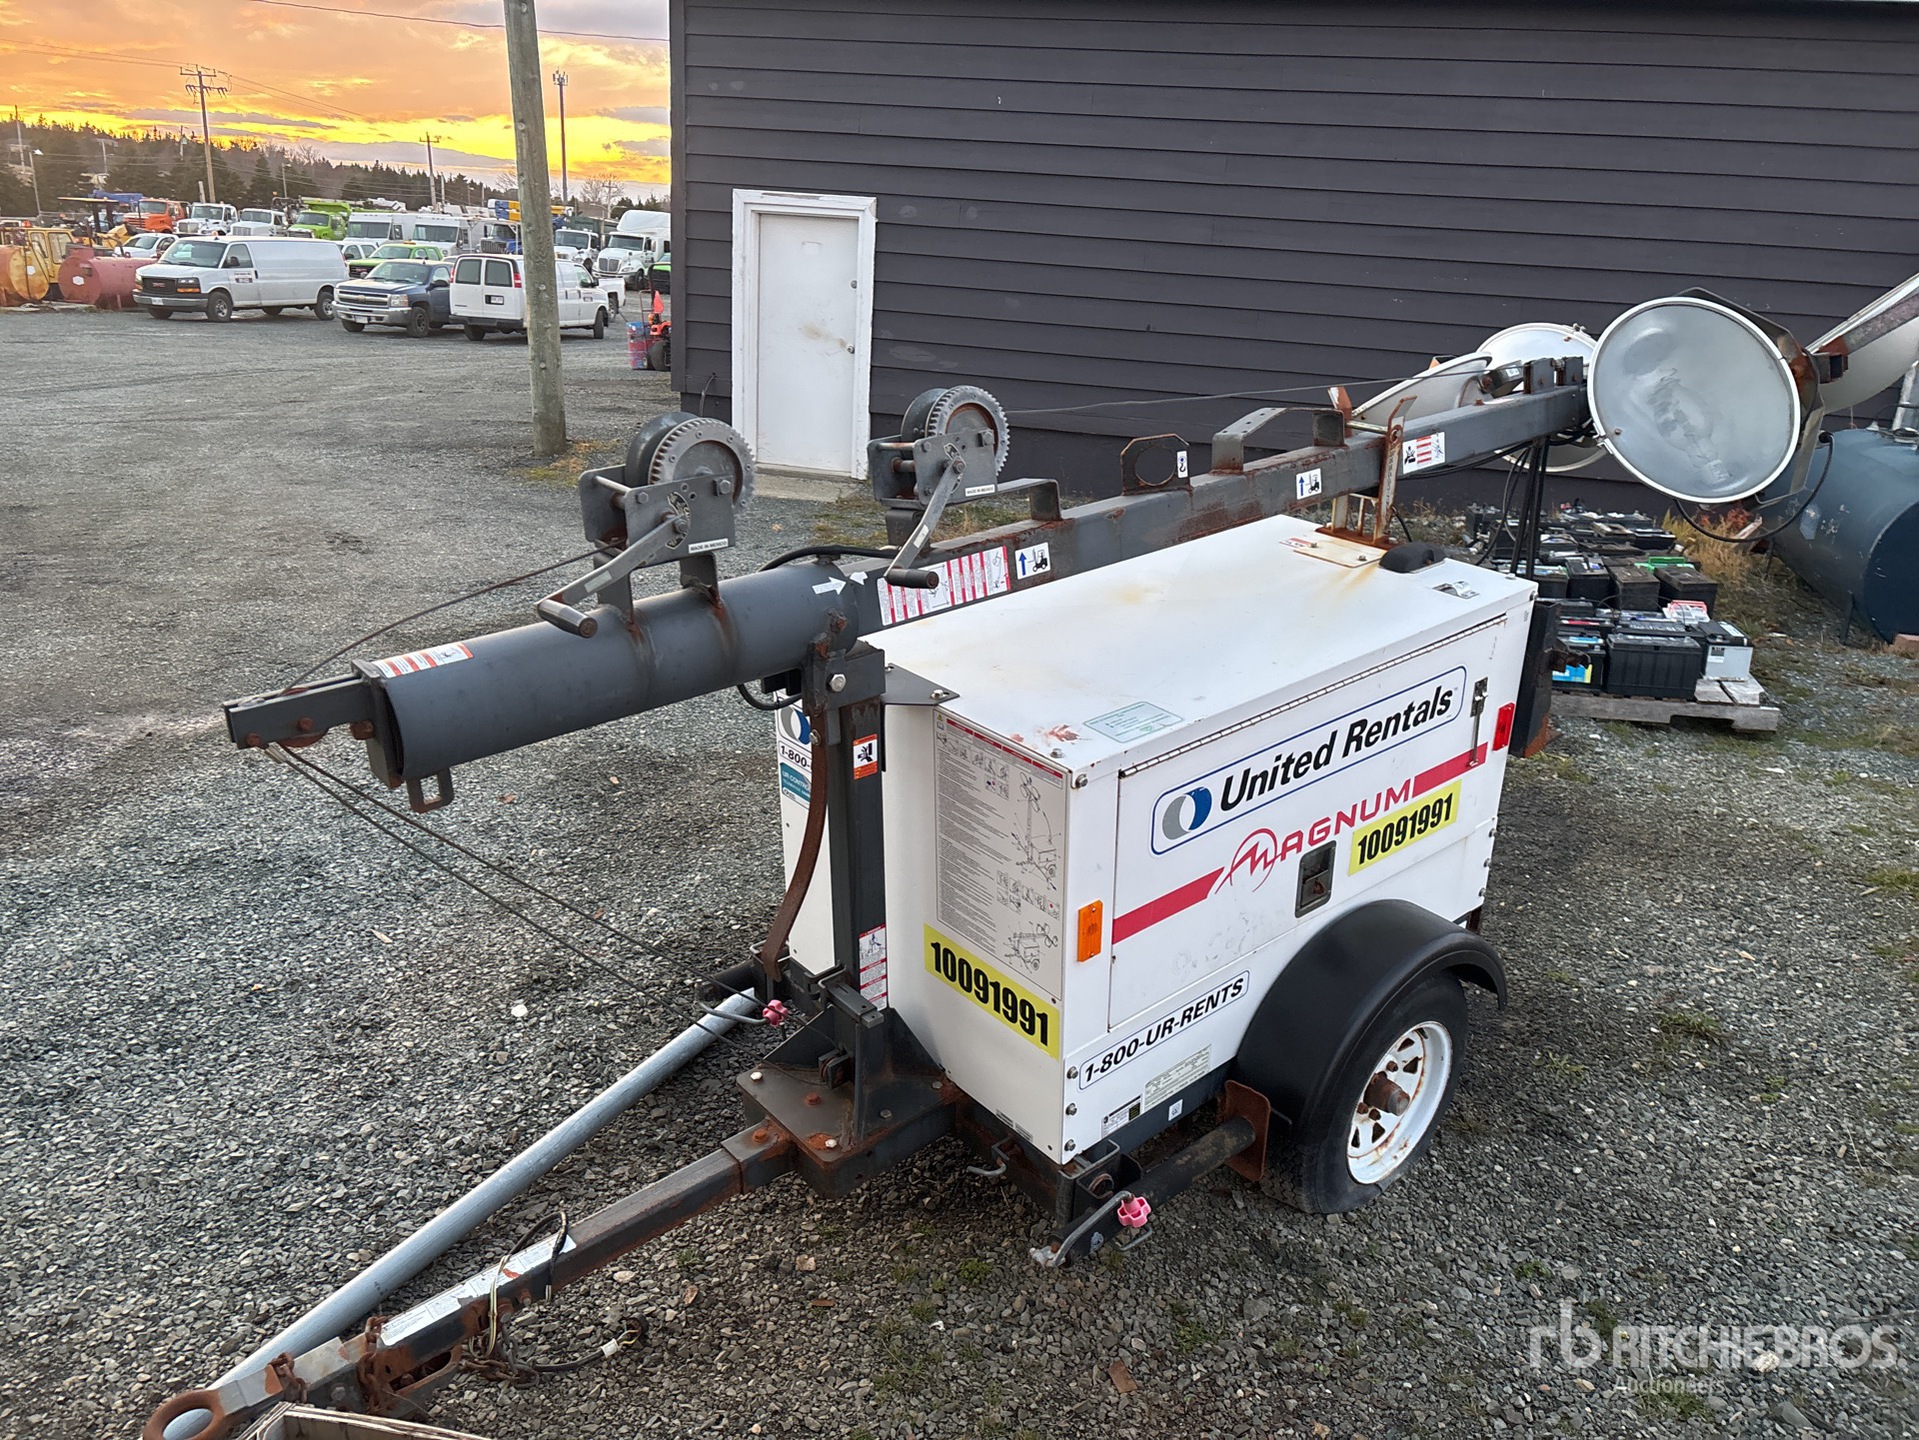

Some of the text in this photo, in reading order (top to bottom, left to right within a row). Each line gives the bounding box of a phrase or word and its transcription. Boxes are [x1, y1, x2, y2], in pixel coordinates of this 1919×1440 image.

[1220, 685, 1453, 812] United Rentals
[1215, 778, 1412, 893] MAGNUM
[1358, 793, 1454, 866] 10091991
[931, 942, 1049, 1047] 10091991
[1085, 978, 1244, 1082] 1-800-UR-RENTS
